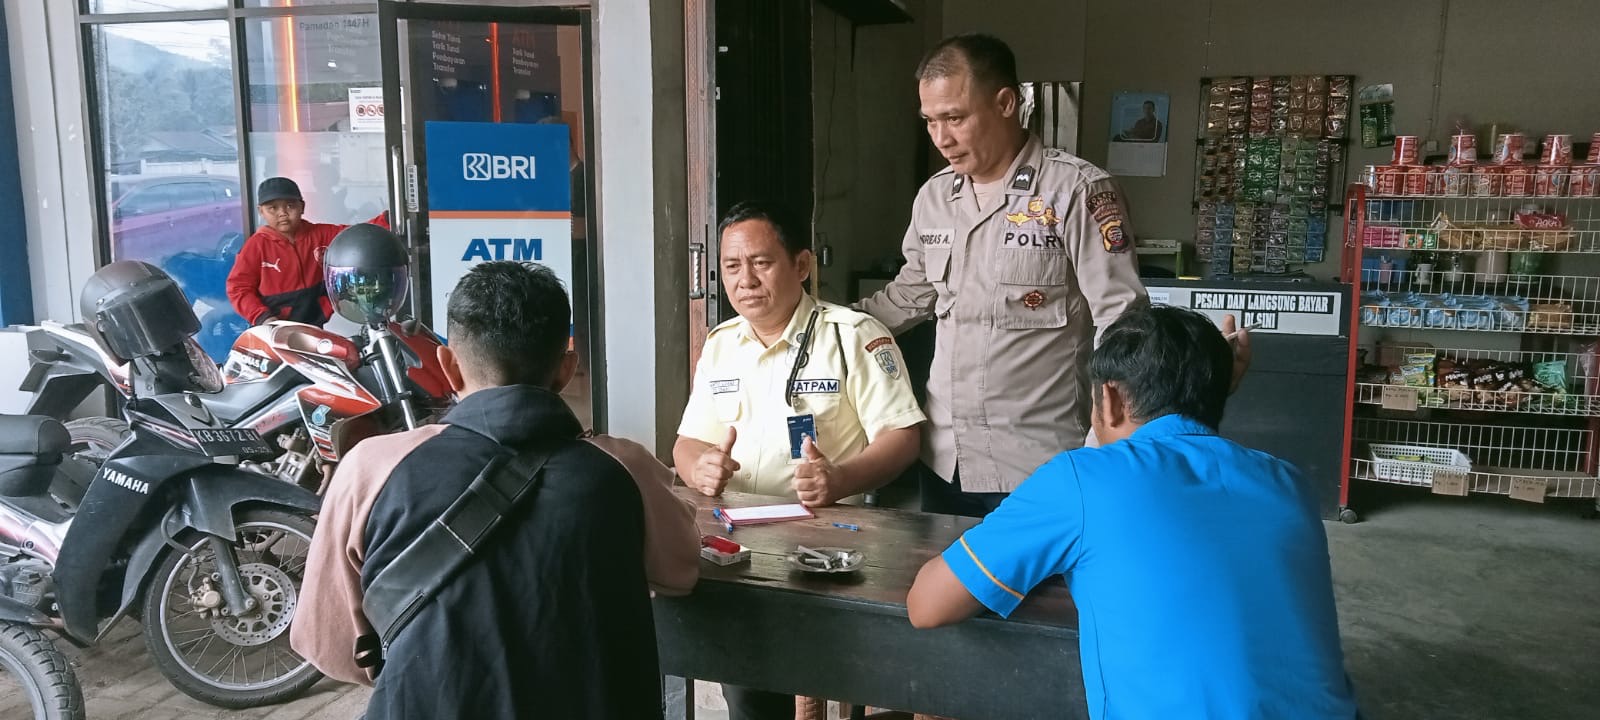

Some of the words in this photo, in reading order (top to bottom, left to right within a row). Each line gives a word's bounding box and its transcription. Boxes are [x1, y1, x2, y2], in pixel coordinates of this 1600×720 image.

[493, 155, 536, 180] BRI
[461, 238, 542, 261] ATM
[1195, 293, 1224, 310] PESAN
[1227, 294, 1245, 310] DAN
[1247, 294, 1296, 312] LANGSUNG
[1298, 296, 1328, 313] BAYAR
[1257, 312, 1275, 329] SINI
[213, 430, 246, 442] 3672
[102, 467, 149, 495] YAMAHA
